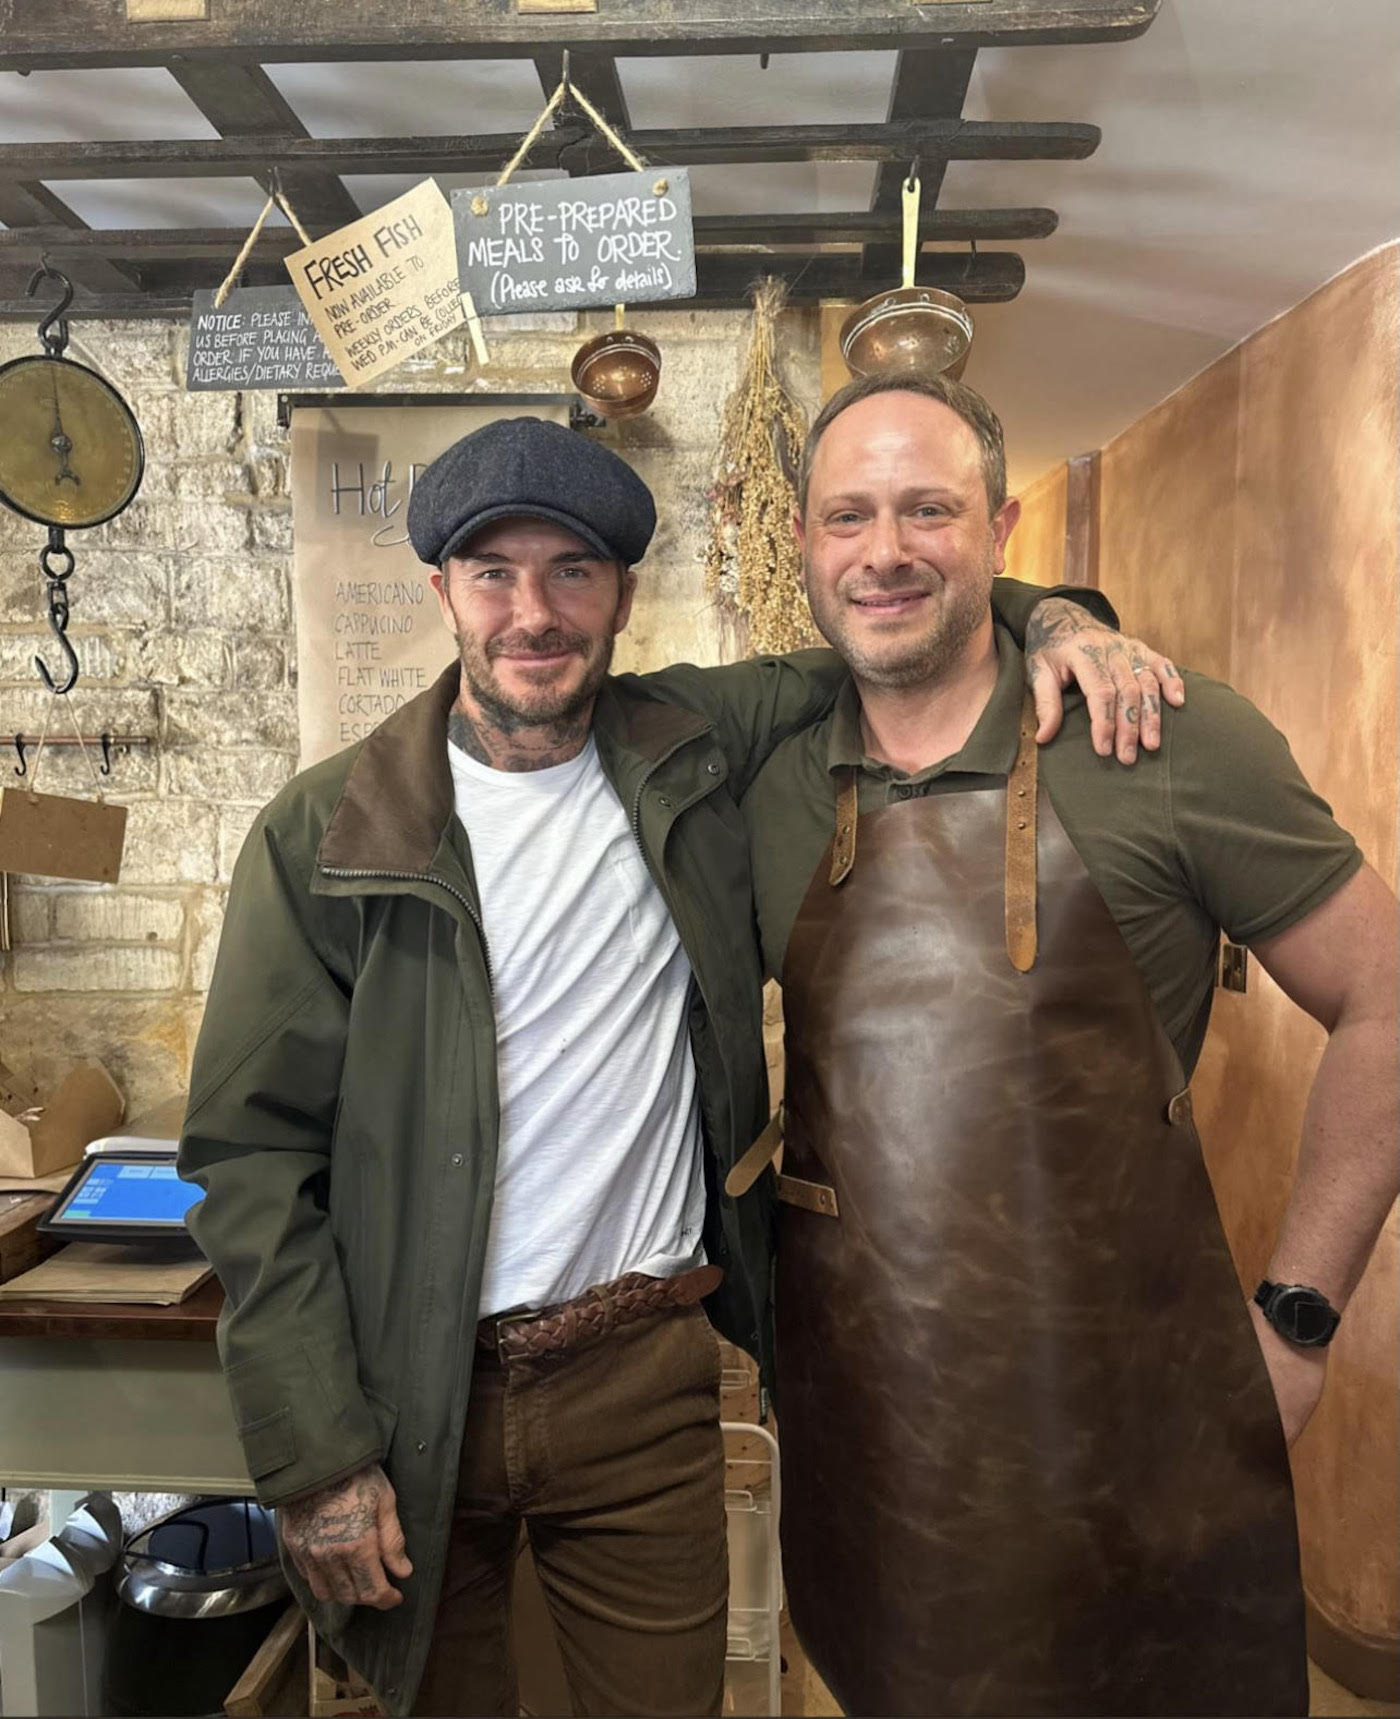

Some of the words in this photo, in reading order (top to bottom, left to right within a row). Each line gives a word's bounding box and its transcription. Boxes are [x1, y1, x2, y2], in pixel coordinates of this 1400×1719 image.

[498, 196, 678, 236] PRE-PREPARED
[303, 244, 374, 300] FRESH
[373, 214, 423, 258] FISH
[468, 237, 545, 269] MEALS
[553, 232, 580, 265] TO
[324, 298, 350, 323] NOW
[349, 265, 407, 310] AVAILABLE
[406, 255, 424, 272] TO
[491, 270, 549, 310] (Please
[554, 275, 586, 294] ask
[586, 264, 610, 293] for
[614, 261, 673, 291] details)
[198, 313, 245, 331] NOTICE:
[251, 311, 291, 328] PLEASE
[297, 311, 313, 326] IN
[345, 328, 383, 358] WEEKLY
[383, 305, 423, 336] ORDERS
[423, 276, 460, 310] BEFORE
[415, 333, 427, 347] ON
[428, 312, 457, 337] FRIDAY
[195, 334, 211, 348] US
[214, 331, 258, 348] BEFORE
[263, 327, 308, 346] PLACING
[313, 330, 322, 343] A
[350, 350, 377, 372] WED
[400, 325, 419, 343] CAN
[420, 314, 433, 330] BE
[435, 293, 462, 322] COLLEC
[193, 349, 233, 367] ORDER
[238, 347, 253, 363] IF
[257, 345, 280, 362] YOU
[285, 345, 317, 361] HAVE
[323, 346, 333, 359] A
[329, 459, 404, 519] Hot
[335, 580, 425, 605] AMERICANO
[334, 611, 414, 636] CAPPUCINO
[335, 640, 383, 661] LATTE
[338, 665, 376, 687] FLAT
[379, 666, 428, 689] WHITE
[338, 692, 406, 717] CORTADO
[339, 720, 380, 743] ESP
